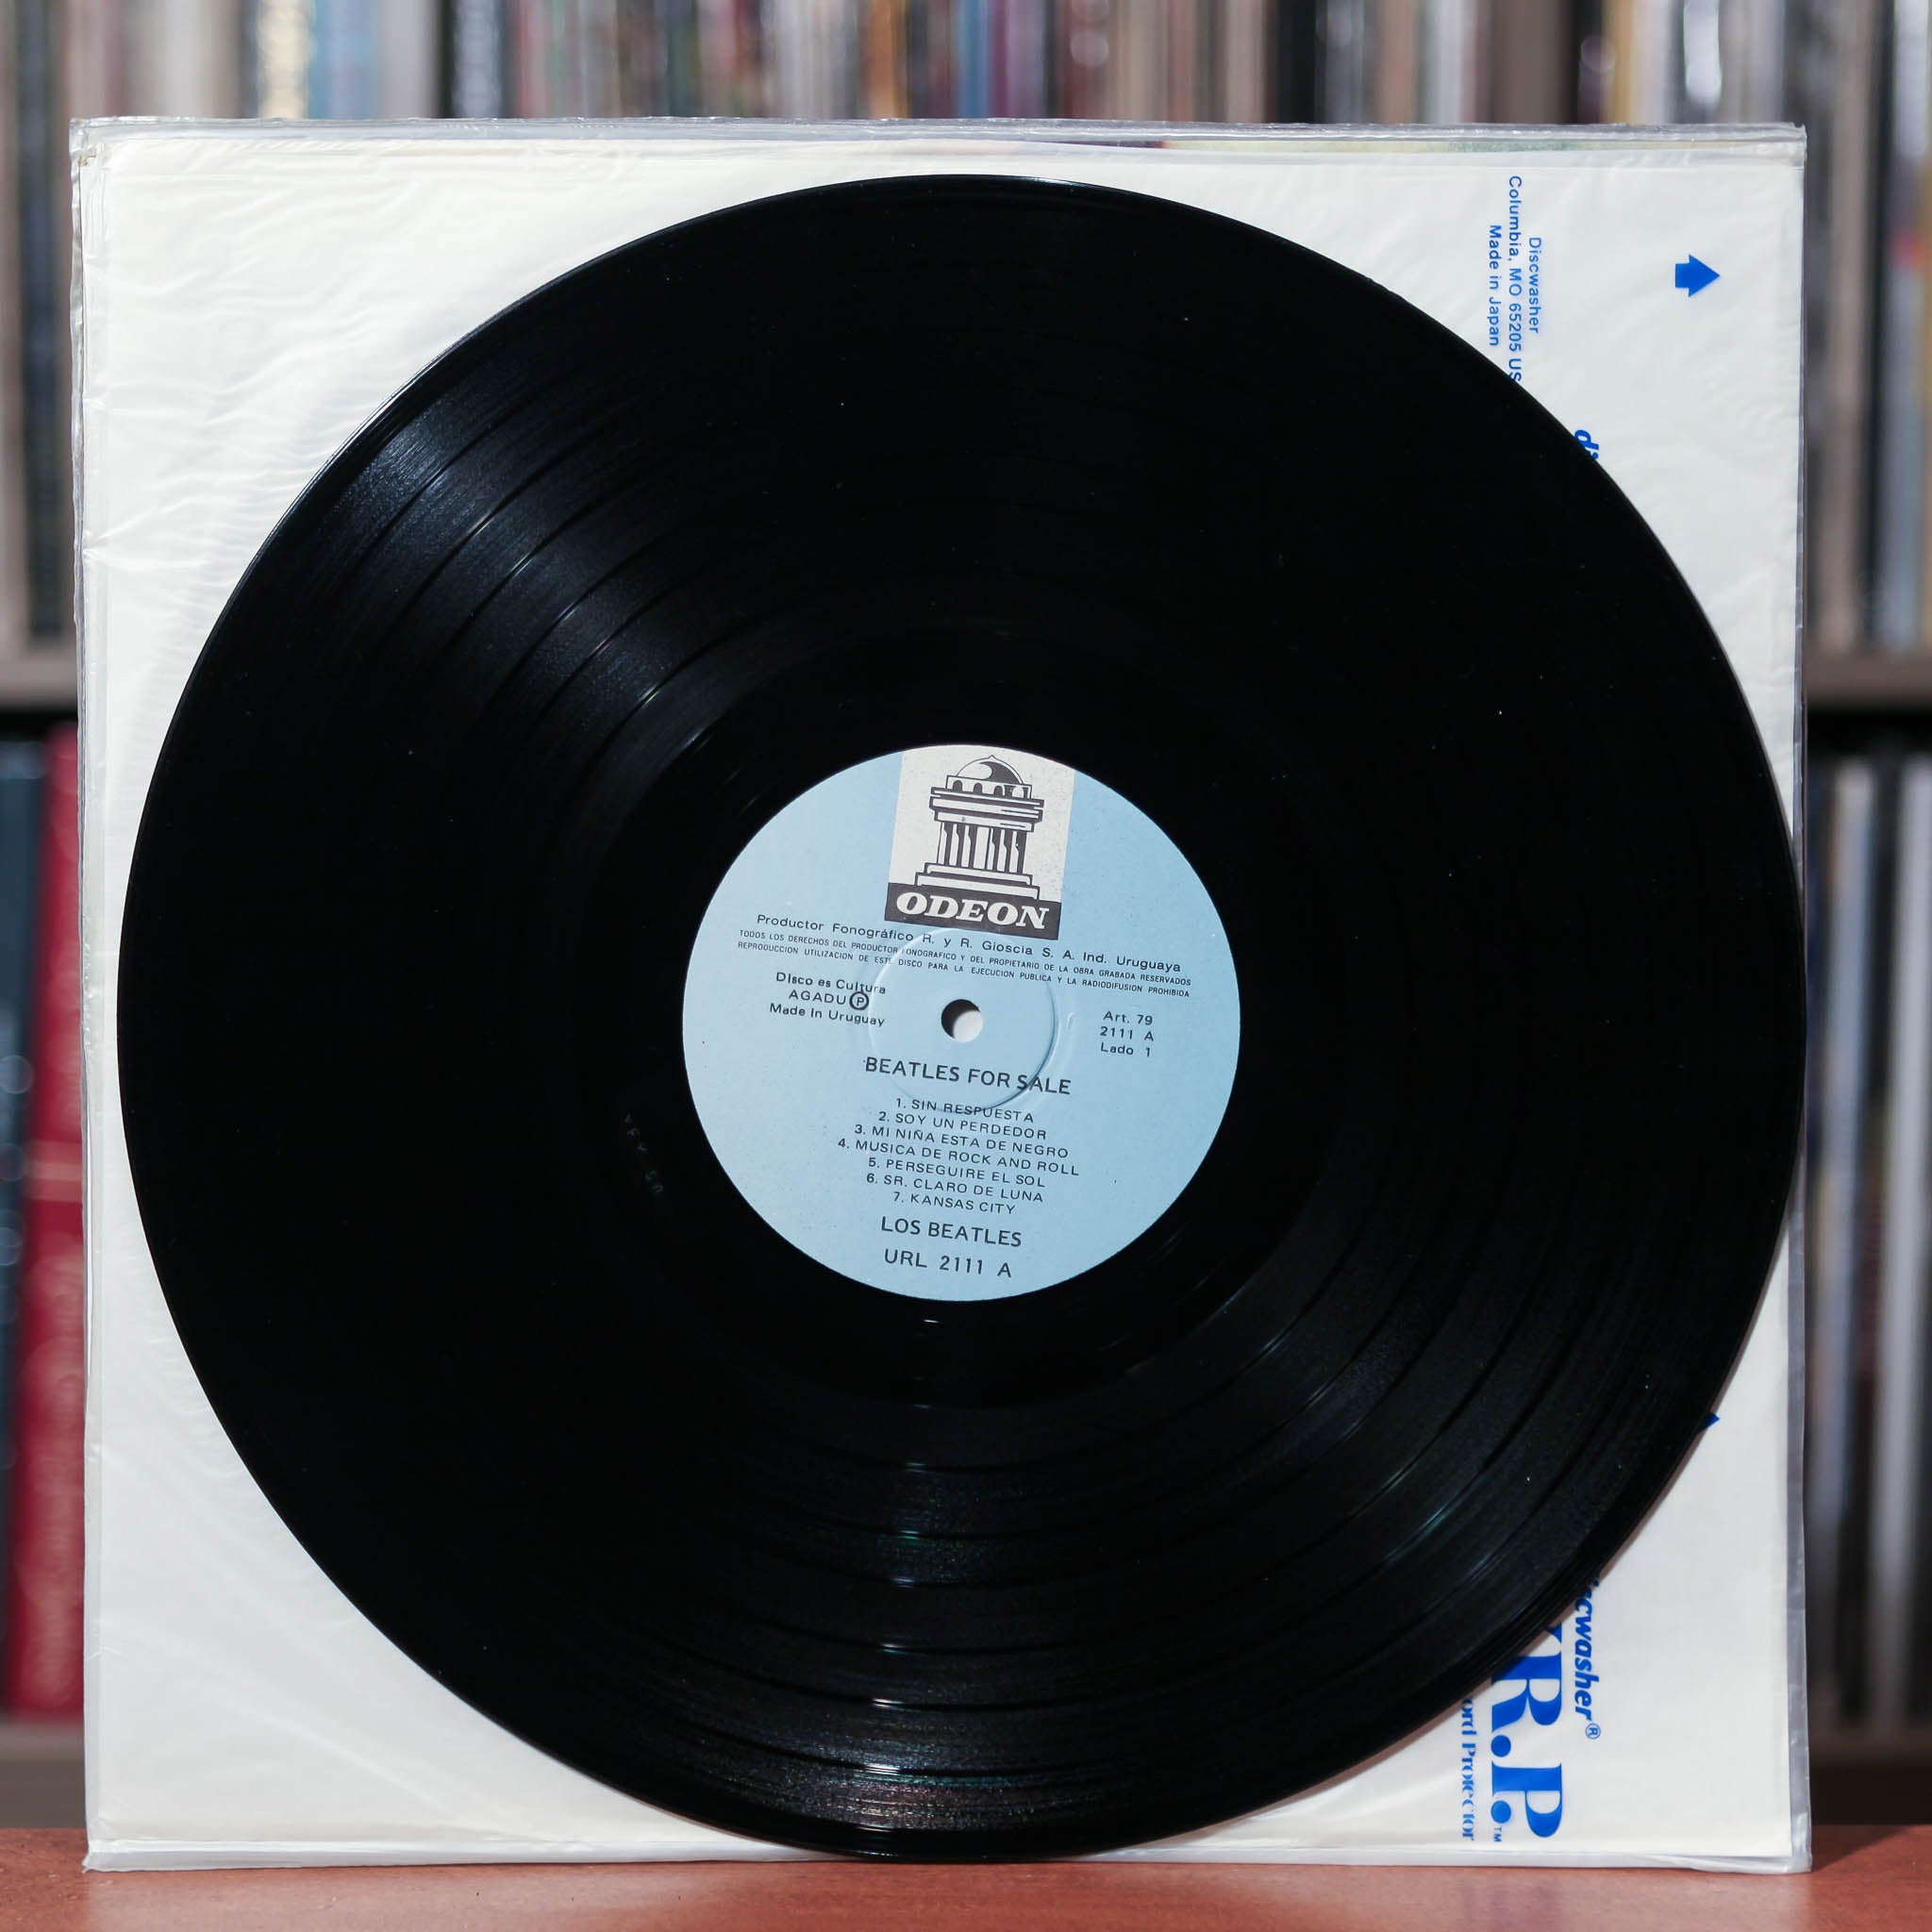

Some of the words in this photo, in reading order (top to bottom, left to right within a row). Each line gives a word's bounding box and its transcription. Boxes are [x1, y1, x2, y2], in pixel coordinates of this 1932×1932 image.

[1508, 175, 1523, 261] Columbia,
[1489, 225, 1502, 270] Made
[1489, 275, 1502, 290] in
[1508, 267, 1522, 296] MO
[1528, 237, 1541, 334] Discwasher
[1487, 297, 1502, 346] Japan
[1508, 304, 1522, 352] 65205
[895, 891, 1049, 929] ODEON
[740, 929, 767, 940] TODOS
[769, 932, 786, 943] LOS
[788, 935, 831, 948] DERECHOS
[832, 940, 848, 949] DEL
[851, 941, 900, 956] PRODUCTOR
[901, 947, 958, 961] ONOGRAFICO
[960, 954, 966, 962] Y
[970, 955, 987, 965] DEL
[988, 957, 1041, 973] PROPIETARIO
[1042, 963, 1056, 973] DE
[1058, 965, 1069, 974] LA
[1072, 966, 1096, 978] OBRA
[1097, 968, 1138, 983] GRABADA
[1139, 973, 1192, 989] RESERVADOS
[757, 914, 825, 931] Productor
[832, 923, 914, 943] Fonográfico
[922, 933, 935, 944] R.
[943, 938, 952, 948] y
[960, 938, 973, 949] R.
[981, 941, 1033, 956] Gioscia
[1041, 947, 1054, 958] S.
[1062, 949, 1075, 960] A.
[1083, 952, 1108, 964] Ind.
[1116, 955, 1181, 974] Uruguaya
[738, 941, 799, 955] REPRODUCCION
[803, 947, 854, 961] UTILIZACION
[858, 954, 871, 963] DE
[897, 958, 924, 969] DISCO
[927, 961, 951, 972] PARA
[954, 964, 964, 973] LA
[971, 966, 1015, 980] EJECUCION
[1019, 971, 1052, 982] PUBLICA
[1057, 975, 1063, 984] Y
[1067, 976, 1077, 986] LA
[1081, 978, 1144, 993] RADIODIFUSION
[1147, 985, 1191, 998] PROHIBIDA
[817, 978, 831, 989] es
[836, 978, 887, 995] Cultura
[770, 1003, 807, 1017] Made
[828, 1009, 886, 1027] Uruguay
[1103, 1010, 1130, 1024] Art.
[1137, 1014, 1154, 1026] 79
[1099, 1025, 1133, 1041] 2111
[1143, 1030, 1155, 1042] A
[1100, 1041, 1134, 1056] Lado
[1145, 1047, 1151, 1058] 1
[865, 1056, 960, 1083] BEATLES
[968, 1068, 1011, 1089] FOR
[1016, 1074, 1072, 1095] SALE
[878, 1110, 891, 1123] 2.
[895, 1112, 927, 1125] SOY
[933, 1117, 955, 1130] UN
[959, 1120, 1047, 1141] PERDEDOR
[896, 1097, 907, 1109] 1.
[911, 1099, 938, 1112] SIN
[941, 1103, 1034, 1124] RESPUESTA
[837, 1138, 850, 1150] 4.
[856, 1139, 916, 1157] MUSICA
[922, 1147, 942, 1159] DE
[948, 1150, 991, 1166] ROCK
[996, 1157, 1032, 1170] AND
[1037, 1160, 1079, 1176] ROLL
[854, 1124, 866, 1136] 3.
[872, 1125, 890, 1139] MI
[895, 1128, 936, 1143] NIÑA
[941, 1133, 980, 1149] ESTA
[986, 1139, 1008, 1152] DE
[1012, 1141, 1069, 1159] NEGRO
[866, 1173, 878, 1185] 6.
[883, 1174, 908, 1188] SR.
[913, 1177, 968, 1194] CLARO
[973, 1185, 994, 1197] DE
[1000, 1188, 1043, 1204] LUNA
[868, 1157, 880, 1169] 5.
[886, 1158, 986, 1180] PERSEGUIRE
[991, 1171, 1011, 1184] EL
[1015, 1174, 1046, 1189] SOL
[893, 1191, 905, 1204] 7.
[910, 1193, 974, 1211] KANSAS
[979, 1202, 1016, 1215] CITY
[881, 1216, 922, 1236] LOS
[927, 1222, 1022, 1248] BEATLES
[884, 1248, 928, 1269] URL
[939, 1255, 983, 1275] 2111
[996, 1262, 1012, 1278] A
